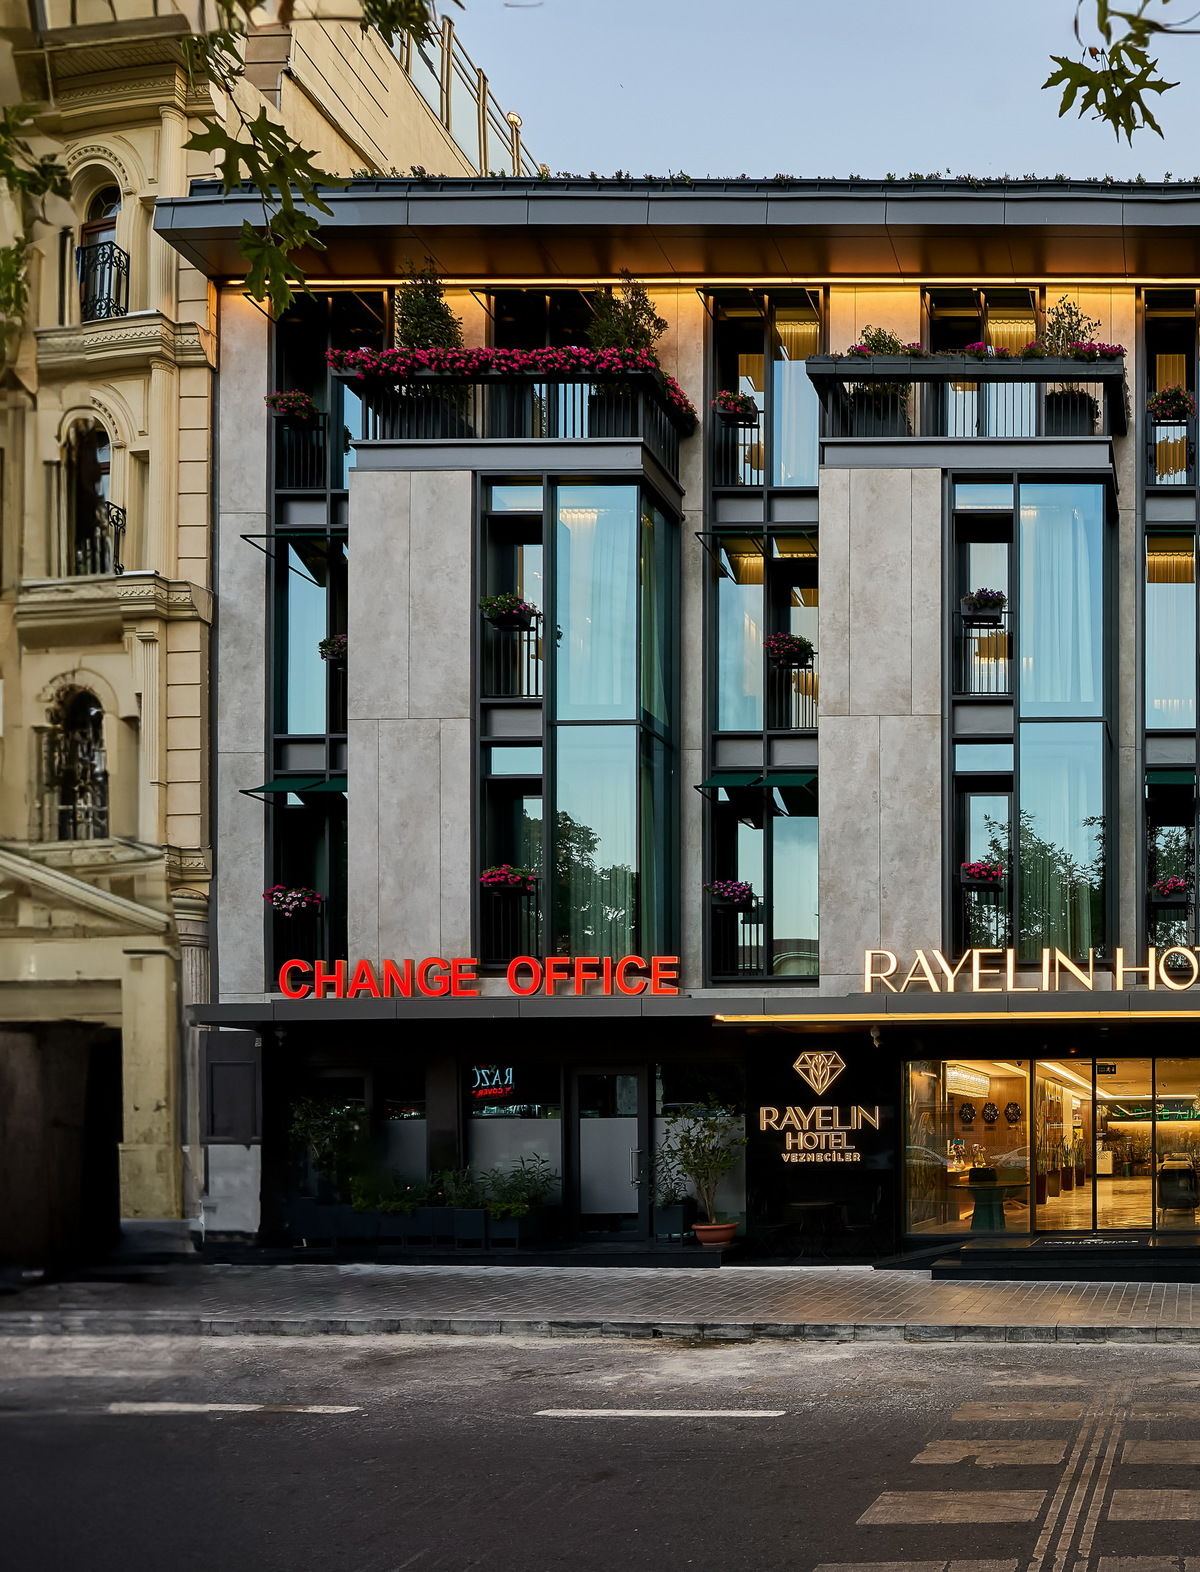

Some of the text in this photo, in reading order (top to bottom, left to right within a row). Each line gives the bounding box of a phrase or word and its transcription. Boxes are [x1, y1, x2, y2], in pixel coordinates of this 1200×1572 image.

[278, 955, 681, 999] CHANGE OFFICE
[863, 947, 1094, 993] RAYELIN
[759, 1105, 879, 1131] RAYELIN
[785, 1131, 856, 1150] HOTEL
